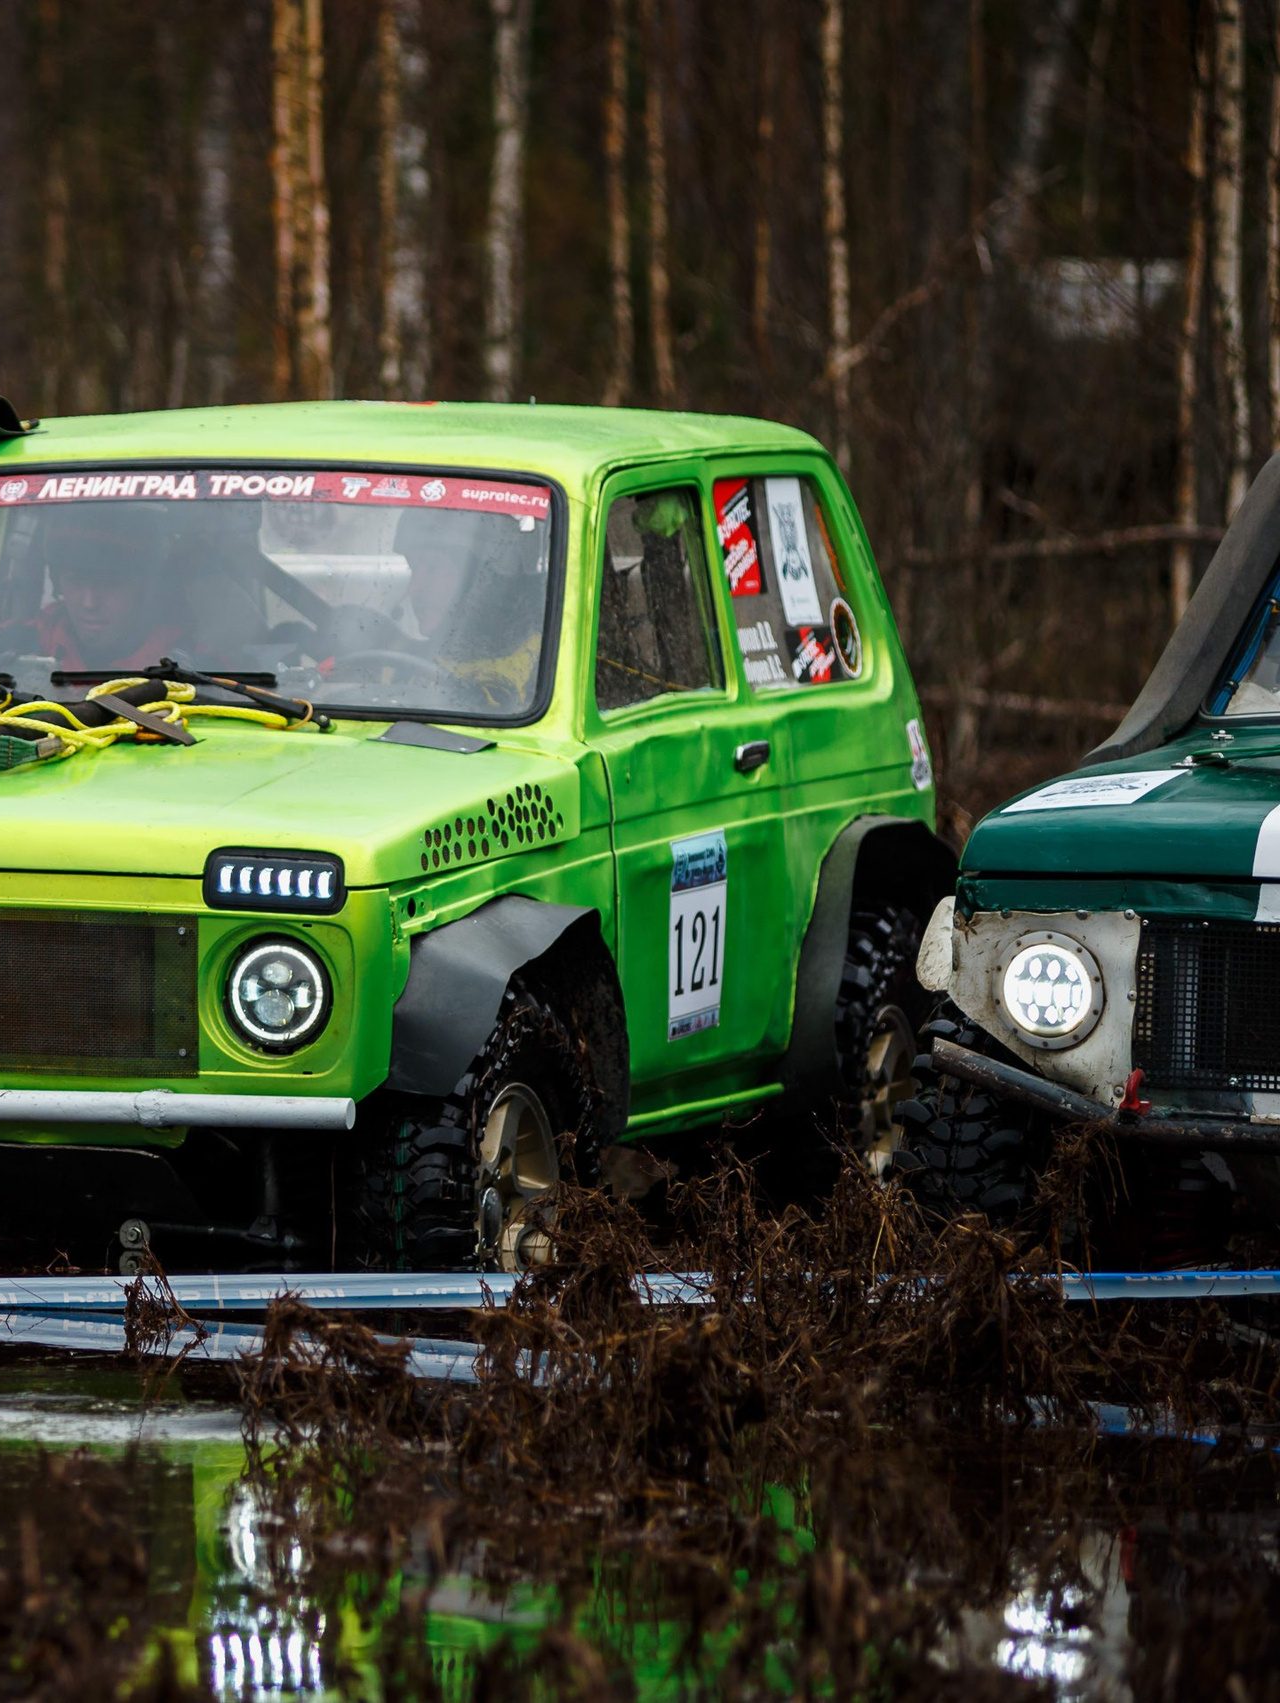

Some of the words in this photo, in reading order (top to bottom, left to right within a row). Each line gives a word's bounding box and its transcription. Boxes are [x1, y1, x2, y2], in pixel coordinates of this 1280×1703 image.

[37, 474, 197, 499] ЛЕНИНГРАД
[209, 475, 316, 498] ТРОФИ
[461, 488, 550, 508] suprotec.ru
[674, 905, 720, 997] 121
